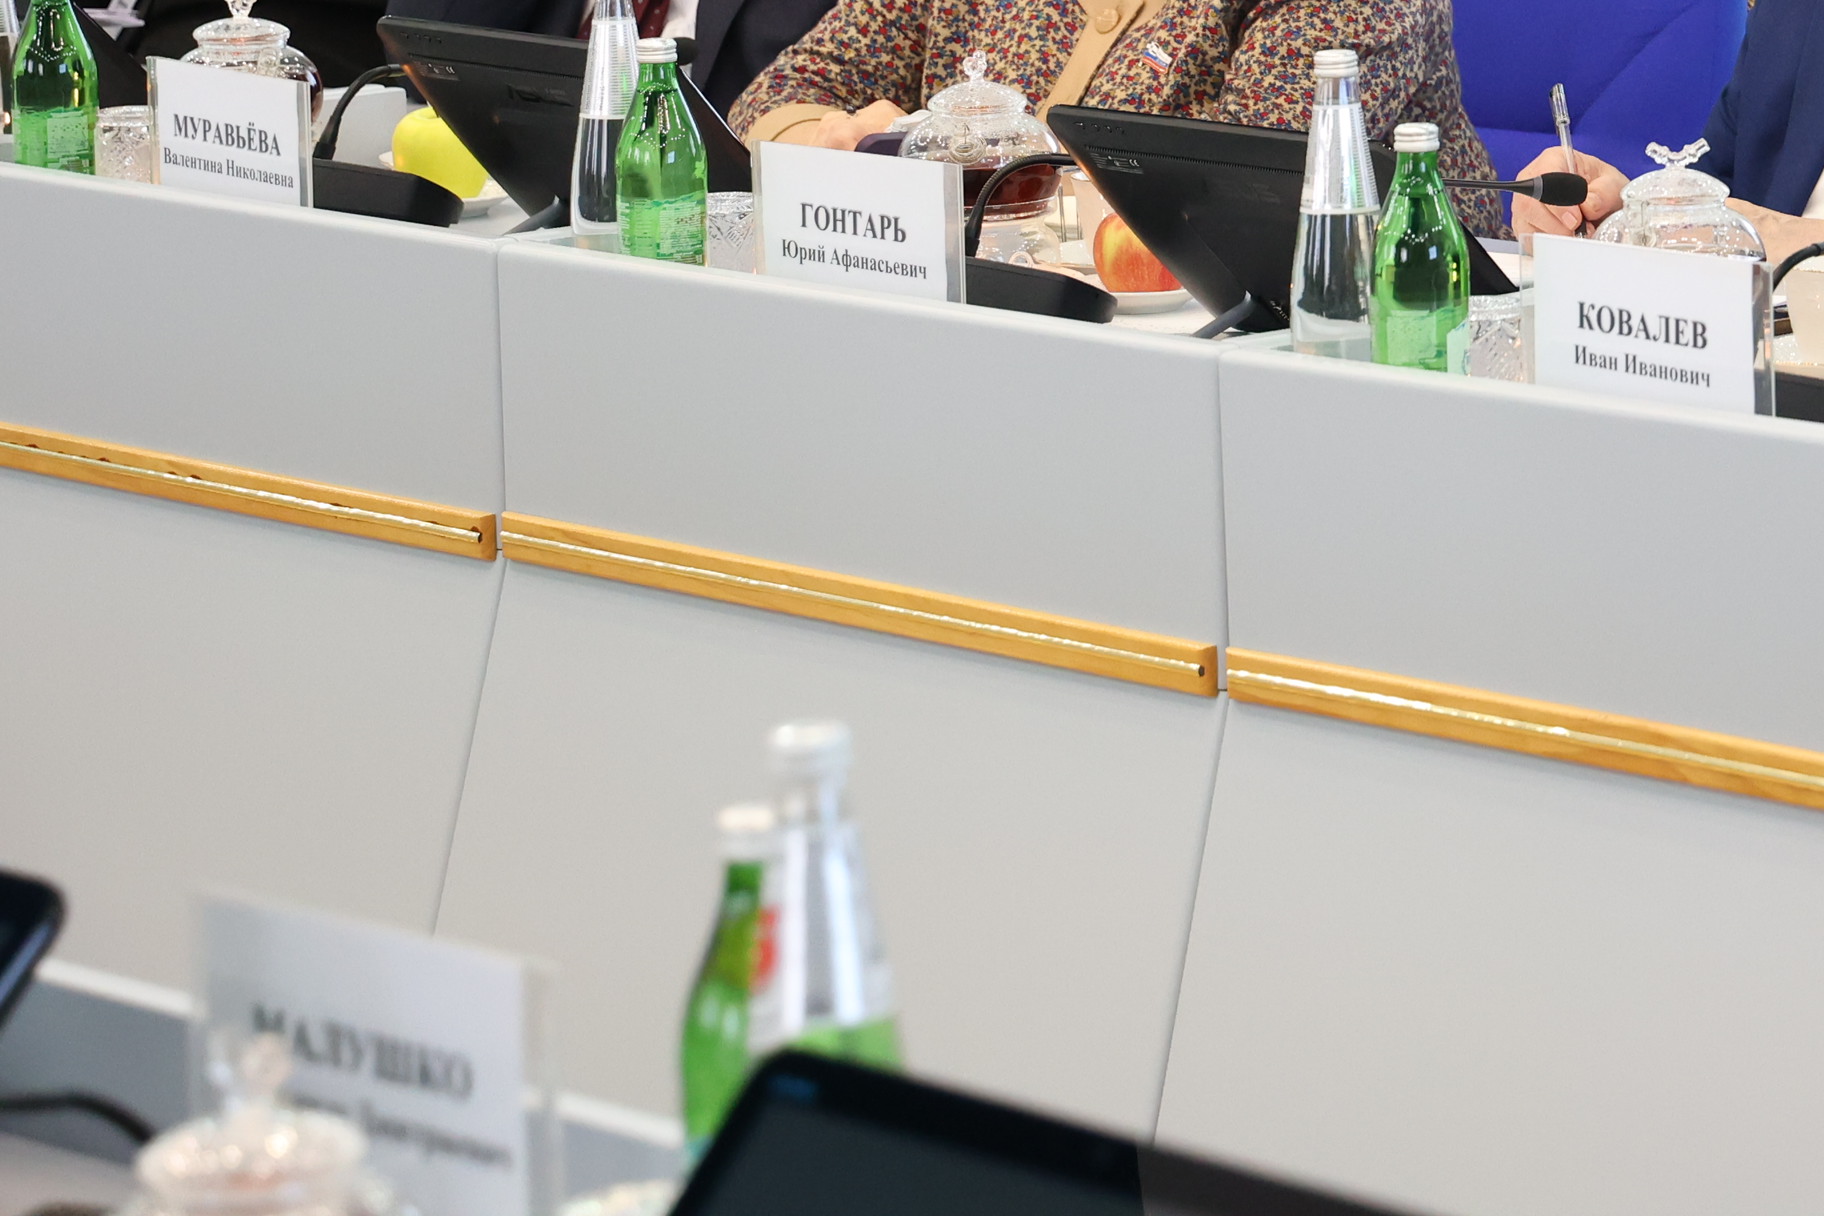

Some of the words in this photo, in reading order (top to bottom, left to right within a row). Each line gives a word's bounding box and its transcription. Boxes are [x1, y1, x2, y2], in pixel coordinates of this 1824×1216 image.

[173, 113, 282, 157] МУРАВЬЁВА
[163, 147, 223, 175] Валентина
[226, 158, 294, 188] Николаевна
[800, 201, 907, 243] ГОНТАРЬ
[781, 238, 826, 265] Юрий
[830, 247, 928, 280] Афанасьевич
[1577, 301, 1708, 350] КОВАЛЕВ
[1573, 344, 1618, 371] Иван
[1624, 352, 1711, 388] Иванович
